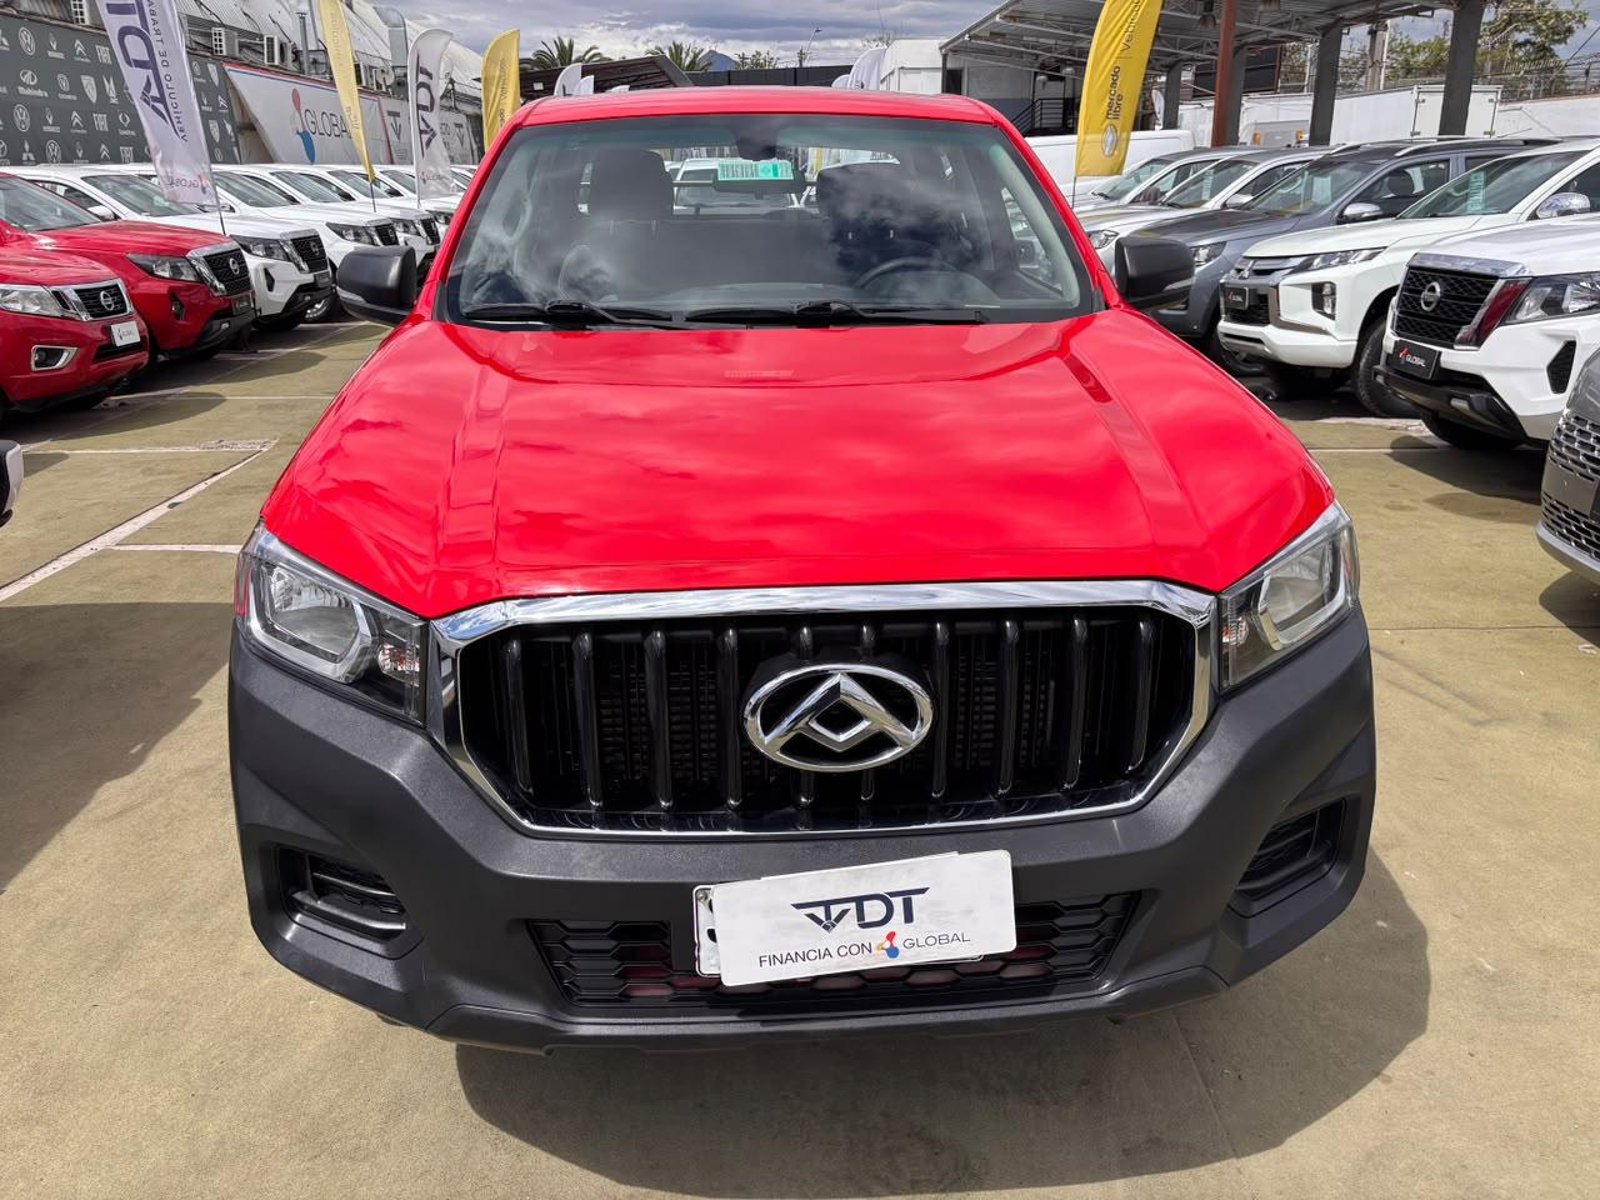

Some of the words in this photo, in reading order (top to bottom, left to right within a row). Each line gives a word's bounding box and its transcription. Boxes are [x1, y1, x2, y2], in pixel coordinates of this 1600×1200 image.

[1105, 65, 1121, 120] mercado
[1112, 93, 1123, 120] libre
[304, 108, 352, 139] GLOBA
[759, 948, 833, 967] FINANCIA
[837, 942, 873, 958] CON
[903, 932, 971, 950] GLOBAL
